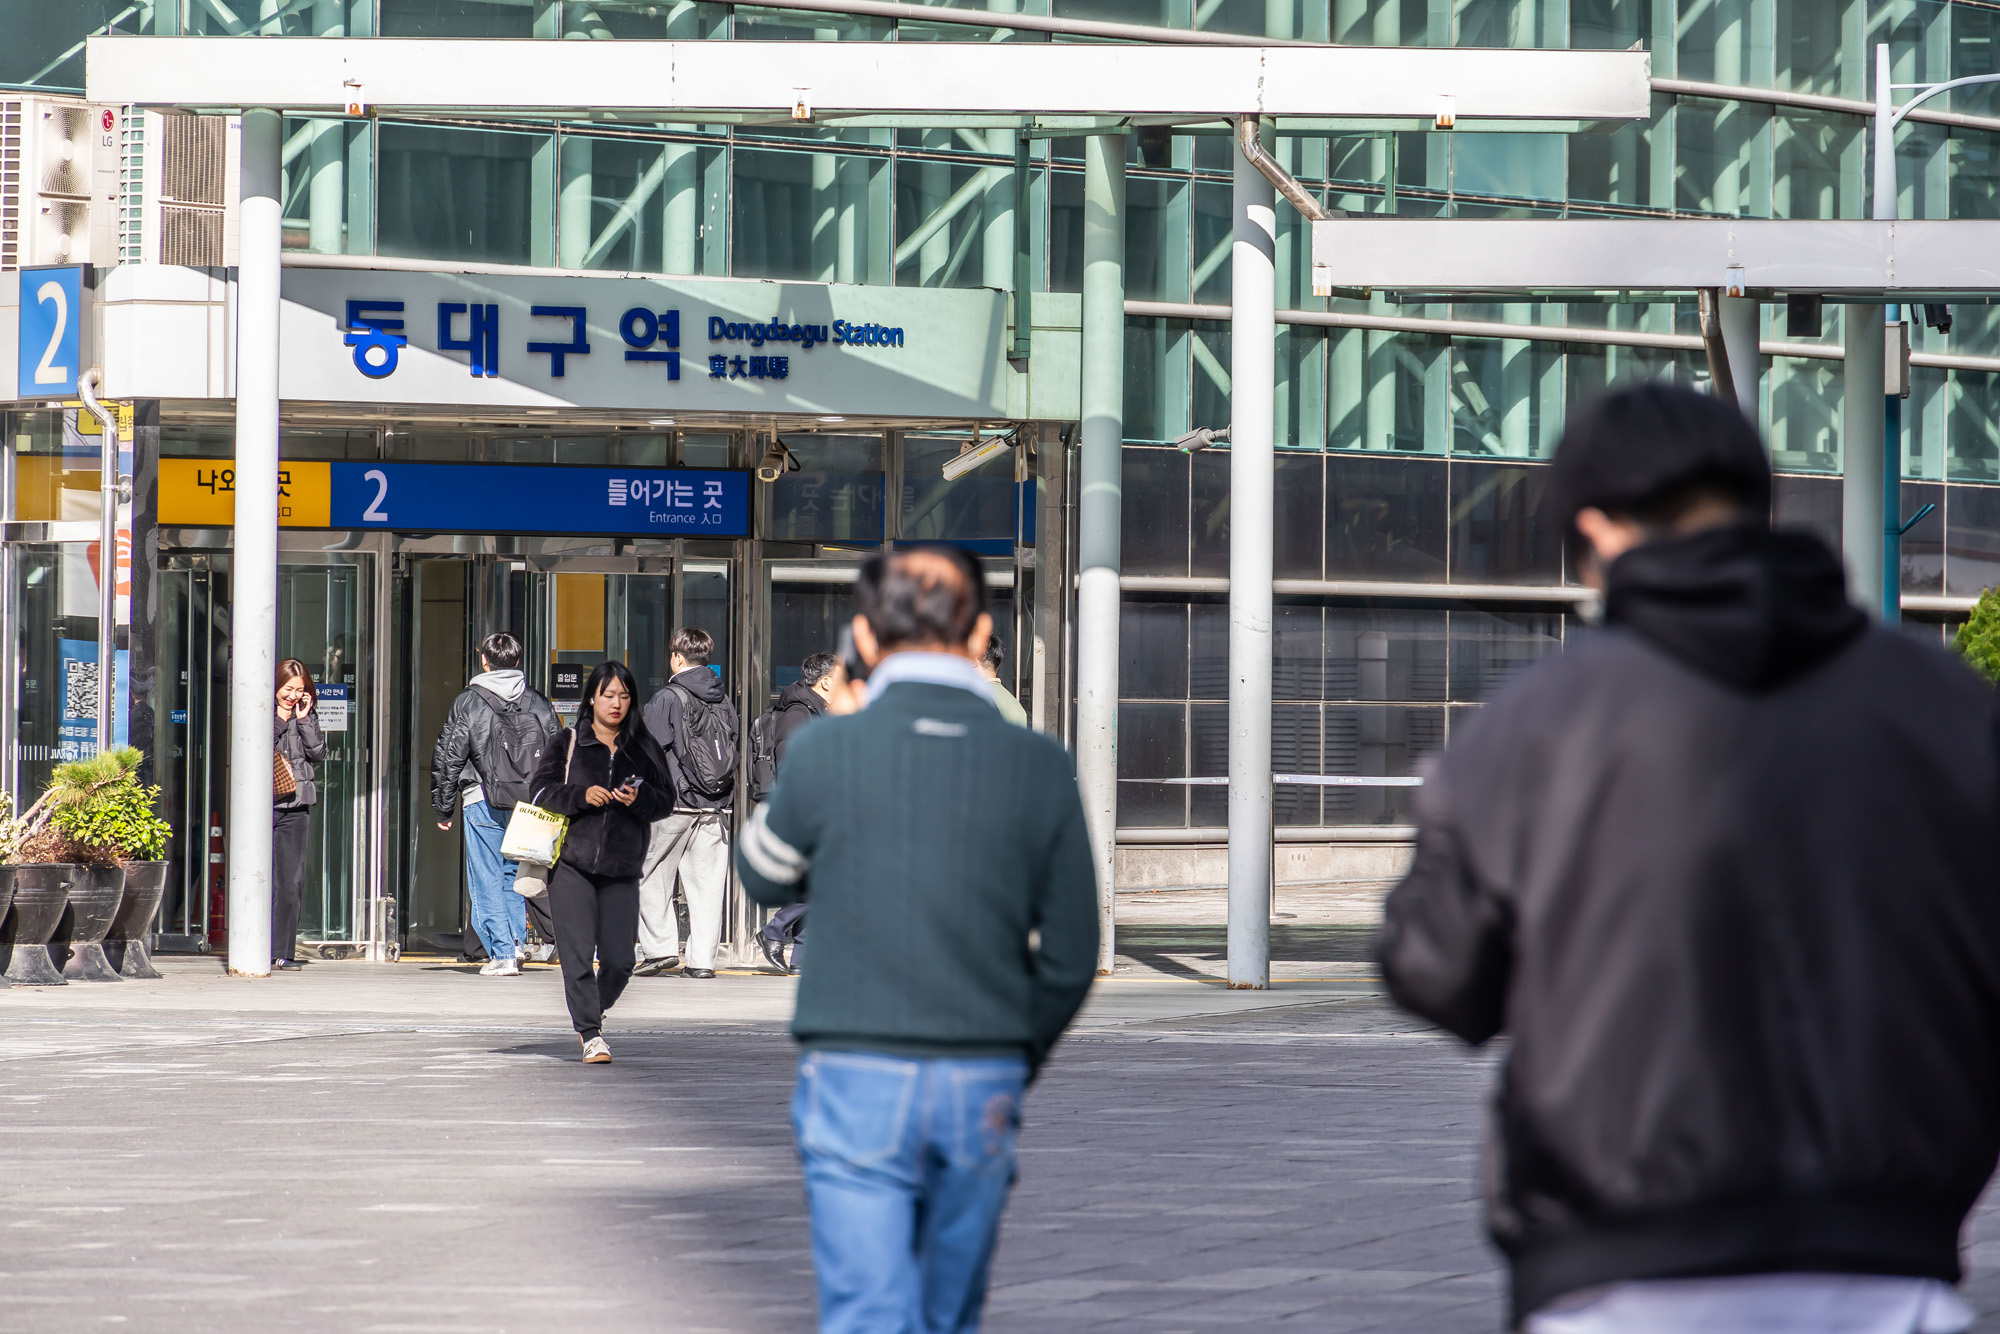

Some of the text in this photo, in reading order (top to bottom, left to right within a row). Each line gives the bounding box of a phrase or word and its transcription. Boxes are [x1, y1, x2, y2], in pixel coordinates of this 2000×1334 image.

[102, 135, 113, 147] LG
[34, 281, 68, 384] 2
[345, 300, 681, 382] 동대구역
[708, 316, 905, 349] Dongdaegu Station
[197, 469, 236, 495] 나오
[608, 478, 723, 509] 들어가는 곳
[362, 469, 388, 522] 2
[649, 511, 696, 524] Entrance
[701, 512, 722, 525] 入口
[557, 673, 578, 683] 출입문
[519, 807, 538, 817] OLIVE
